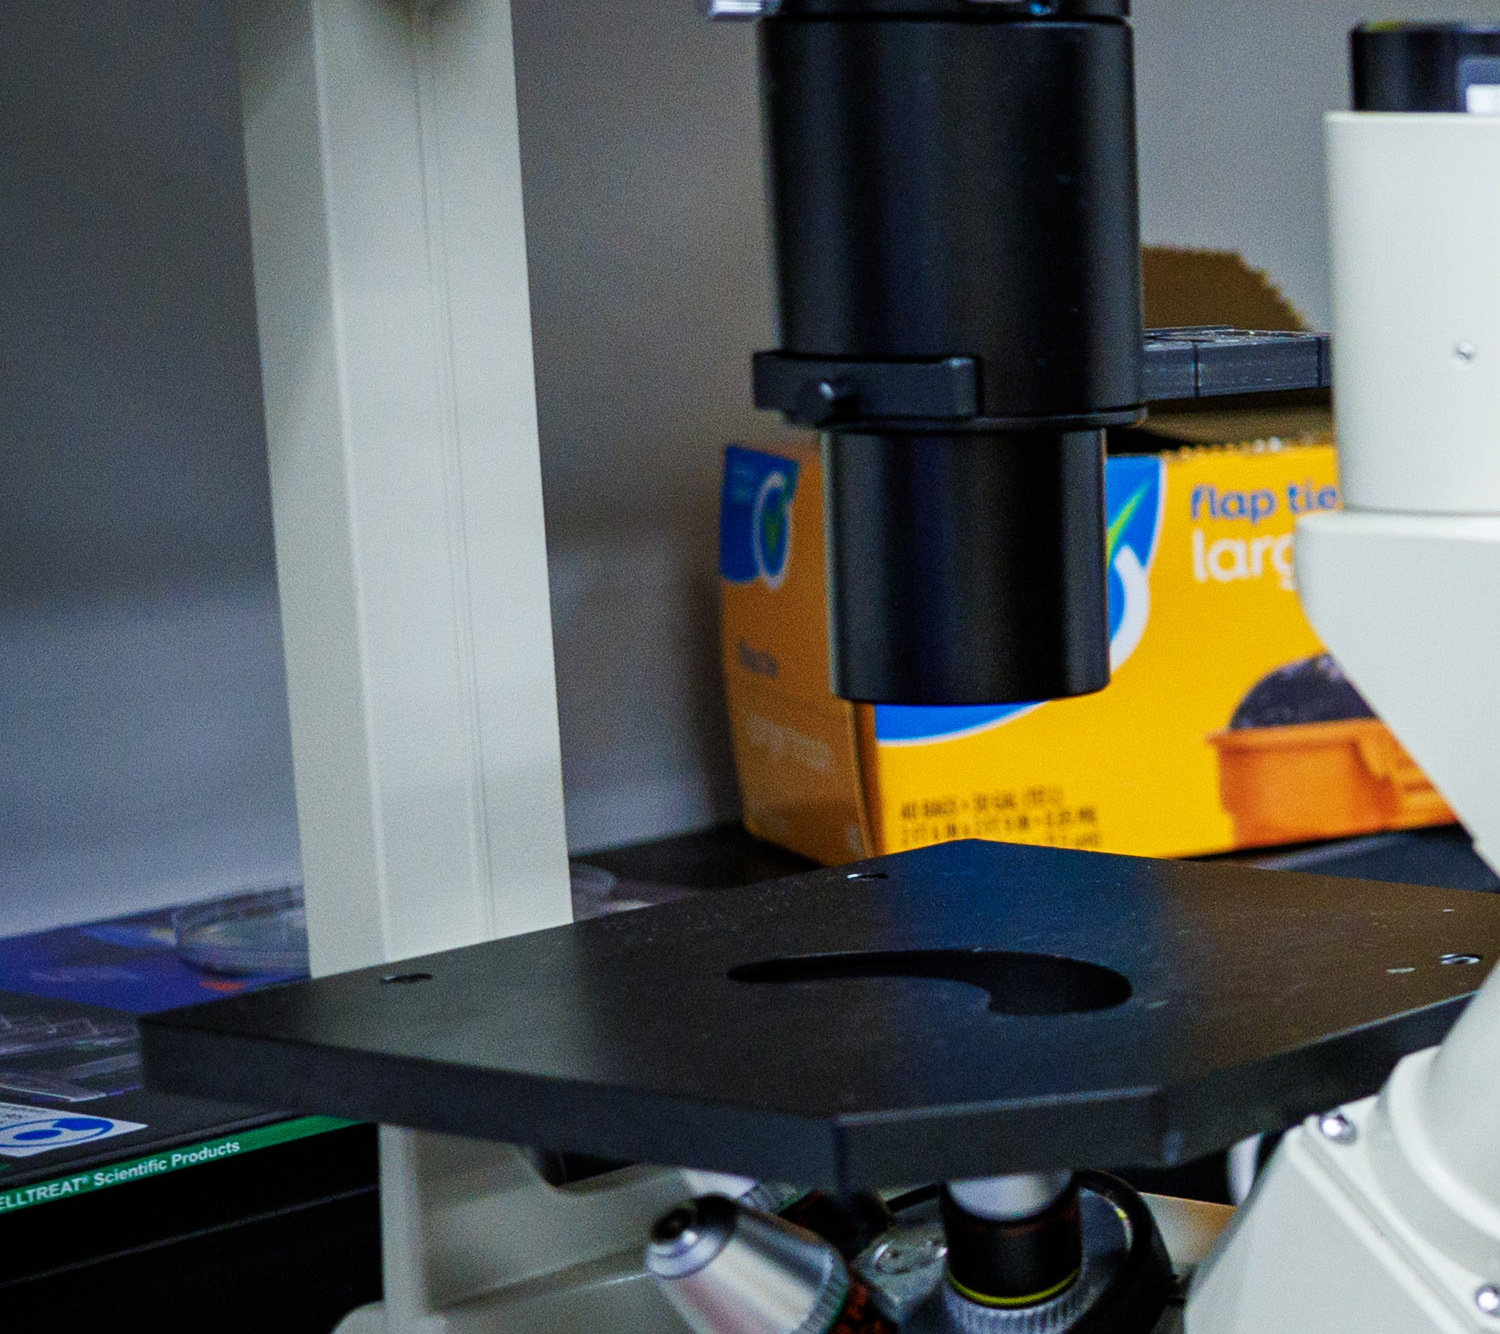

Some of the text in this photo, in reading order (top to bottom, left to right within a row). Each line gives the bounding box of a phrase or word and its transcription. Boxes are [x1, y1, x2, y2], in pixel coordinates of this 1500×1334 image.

[1189, 485, 1277, 526] flap
[94, 1158, 167, 1188] Scientific
[171, 1140, 241, 1168] Products
